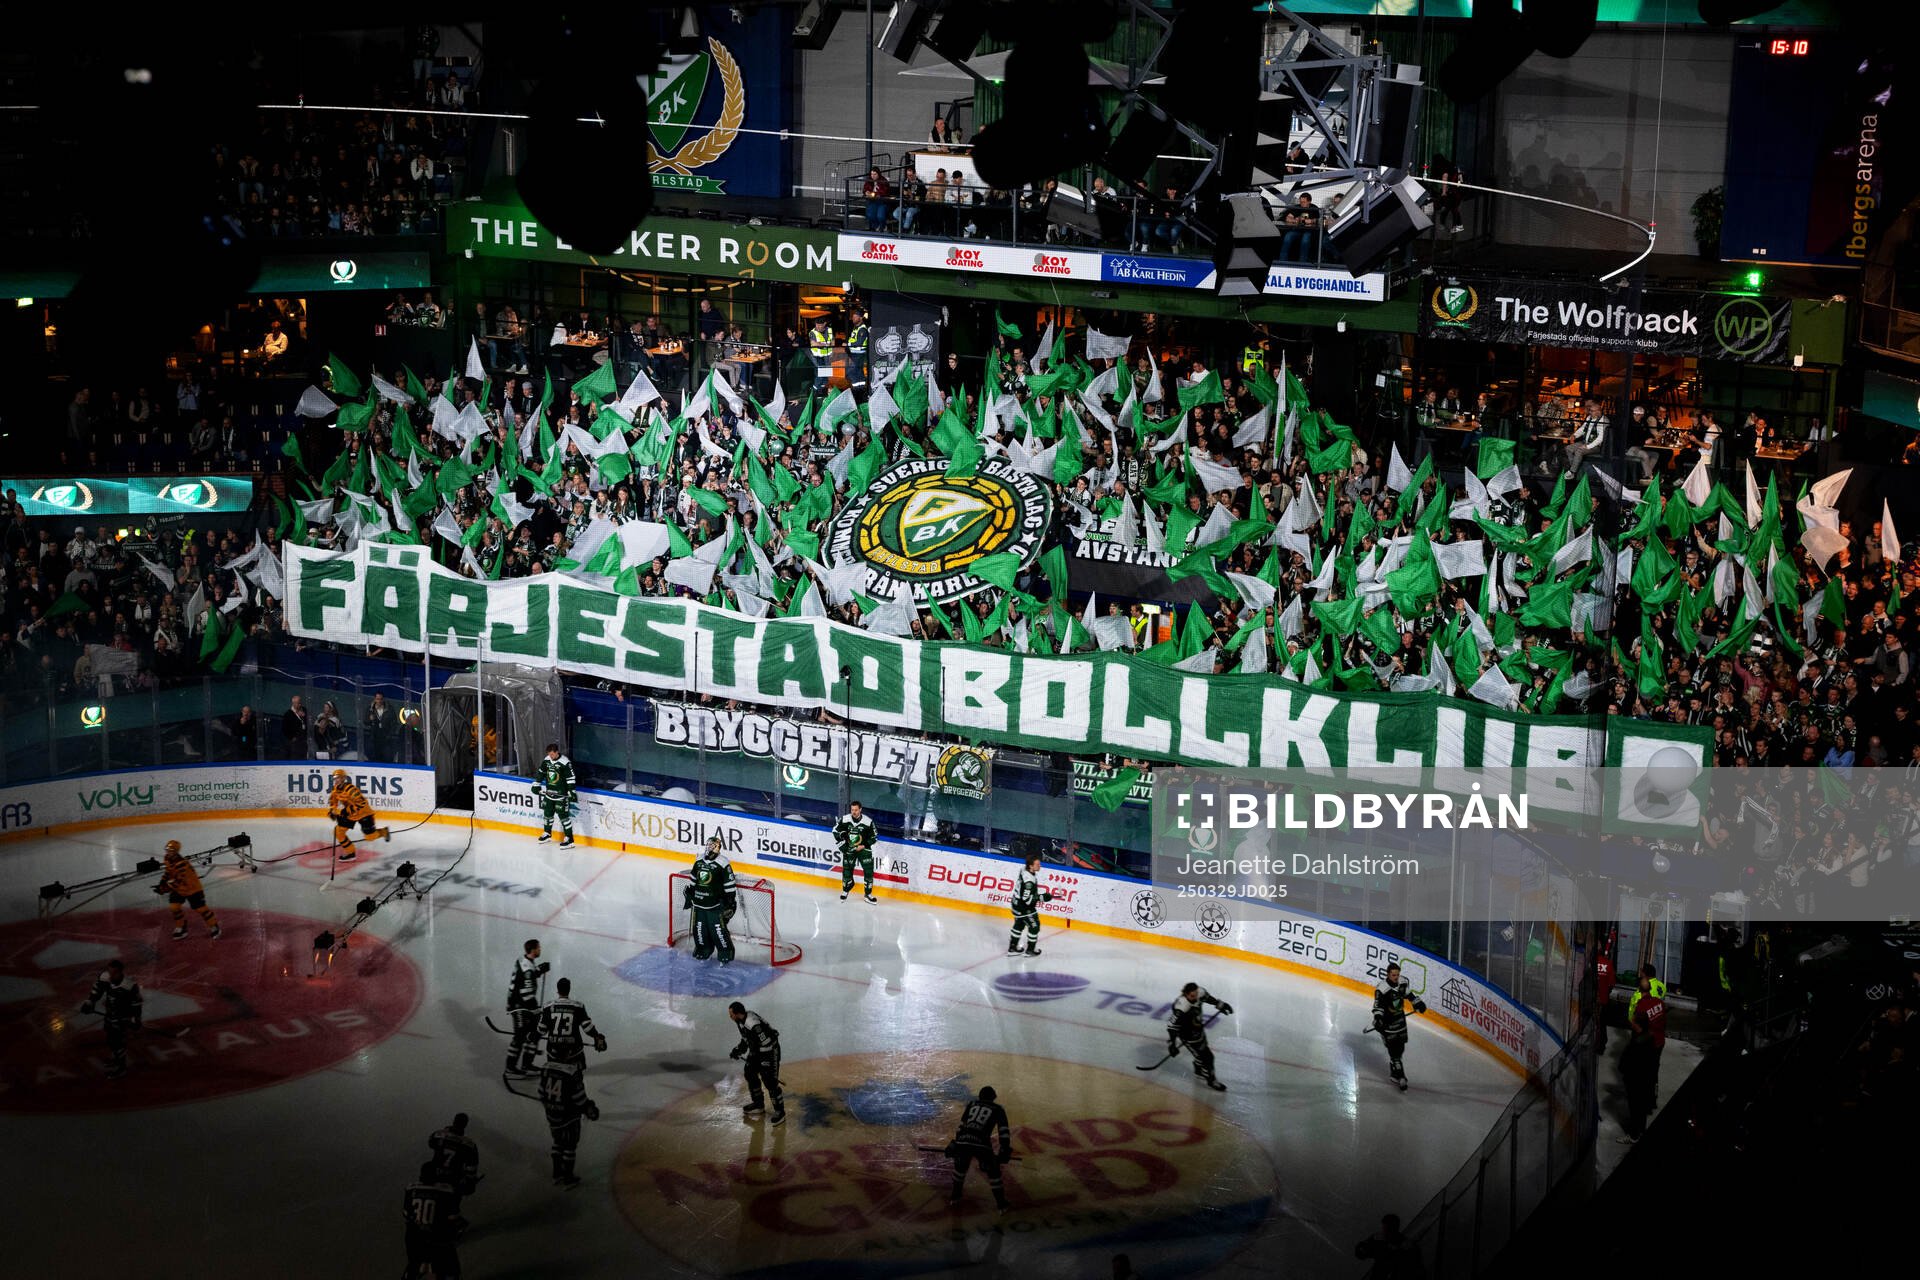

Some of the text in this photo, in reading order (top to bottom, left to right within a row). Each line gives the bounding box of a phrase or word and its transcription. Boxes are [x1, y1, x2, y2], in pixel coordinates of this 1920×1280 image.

[1771, 40, 1808, 55] 15:10
[471, 217, 832, 272] THE LKER ROOM
[871, 242, 896, 254] KOY
[861, 251, 898, 261] COATING
[946, 258, 984, 268] COATING
[955, 249, 981, 260] KOY
[1042, 255, 1068, 267] KOY
[1032, 264, 1071, 275] COATING
[1117, 267, 1131, 278] AB
[1295, 276, 1371, 293] BYGGHANDEL.
[1495, 297, 1698, 336] The Wolfpack
[1721, 316, 1769, 338] WP
[1527, 331, 1567, 343] Färjestads
[1568, 334, 1599, 344] officiella
[911, 515, 964, 543] BK
[864, 568, 908, 600] RÅN
[299, 546, 904, 714] FÄRJESTAD
[656, 703, 939, 786] BRYGGERIET
[1072, 762, 1109, 778] VILA
[177, 780, 249, 792] Brand merch
[287, 769, 404, 796] HÖJENS
[78, 781, 154, 811] voky
[178, 791, 240, 802] made easy
[479, 785, 534, 808] Svema
[943, 785, 985, 800] BRYGGERIET
[757, 827, 769, 836] DT
[890, 860, 909, 875] AB
[928, 863, 1078, 902] Budpaner
[1278, 920, 1315, 939] pre
[1278, 938, 1327, 962] zero
[1366, 944, 1399, 964] pre
[1094, 989, 1221, 1030] Tela
[1481, 996, 1526, 1037] KARLSTADS
[550, 1012, 574, 1037] 73
[967, 1104, 993, 1123] 98
[411, 1198, 436, 1225] 30
